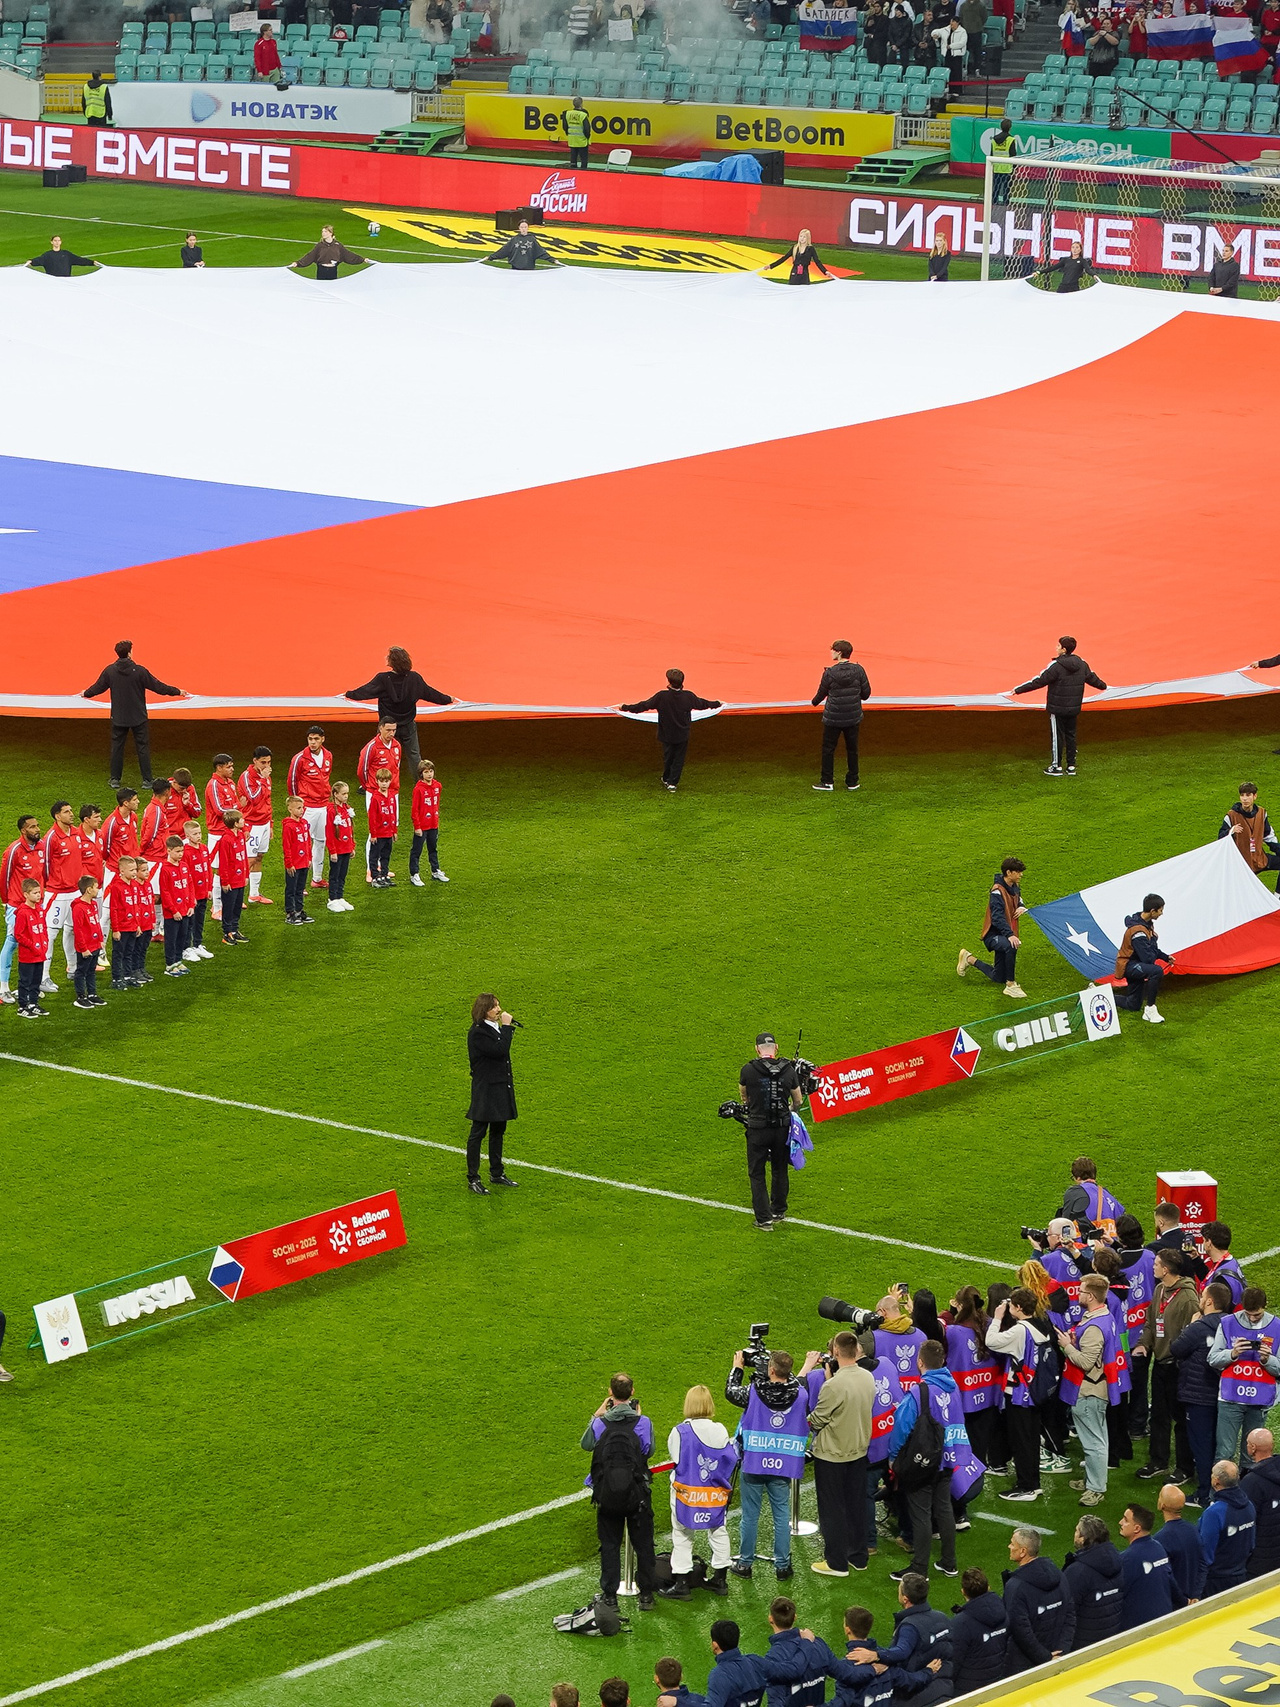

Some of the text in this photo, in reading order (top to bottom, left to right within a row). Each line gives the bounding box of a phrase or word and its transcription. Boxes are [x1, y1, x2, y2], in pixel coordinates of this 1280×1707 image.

[231, 102, 338, 121] НОВАТЭК
[524, 106, 651, 136] Beoom
[716, 115, 844, 147] BetBoom
[96, 130, 291, 190] ВМЕСТЕ
[530, 193, 588, 213] РОССИИ
[849, 197, 1133, 266] СИЛЬНЫЕ
[54, 906, 61, 918] 3
[995, 1012, 1072, 1052] CHILE
[884, 1056, 925, 1075] SOCHI 2025
[838, 1067, 874, 1084] BetBoom
[843, 1086, 871, 1102] СБОРНОЙ
[351, 1208, 390, 1229] BetBoom
[272, 1236, 318, 1258] SOCHI 2025
[356, 1229, 387, 1247] СБОРНОЙ
[102, 1275, 196, 1327] RUSSIA
[964, 1372, 992, 1386] ФОТО
[973, 1392, 985, 1406] 173
[1236, 1385, 1257, 1397] 089
[761, 1457, 783, 1470] 030
[693, 1512, 711, 1524] 025
